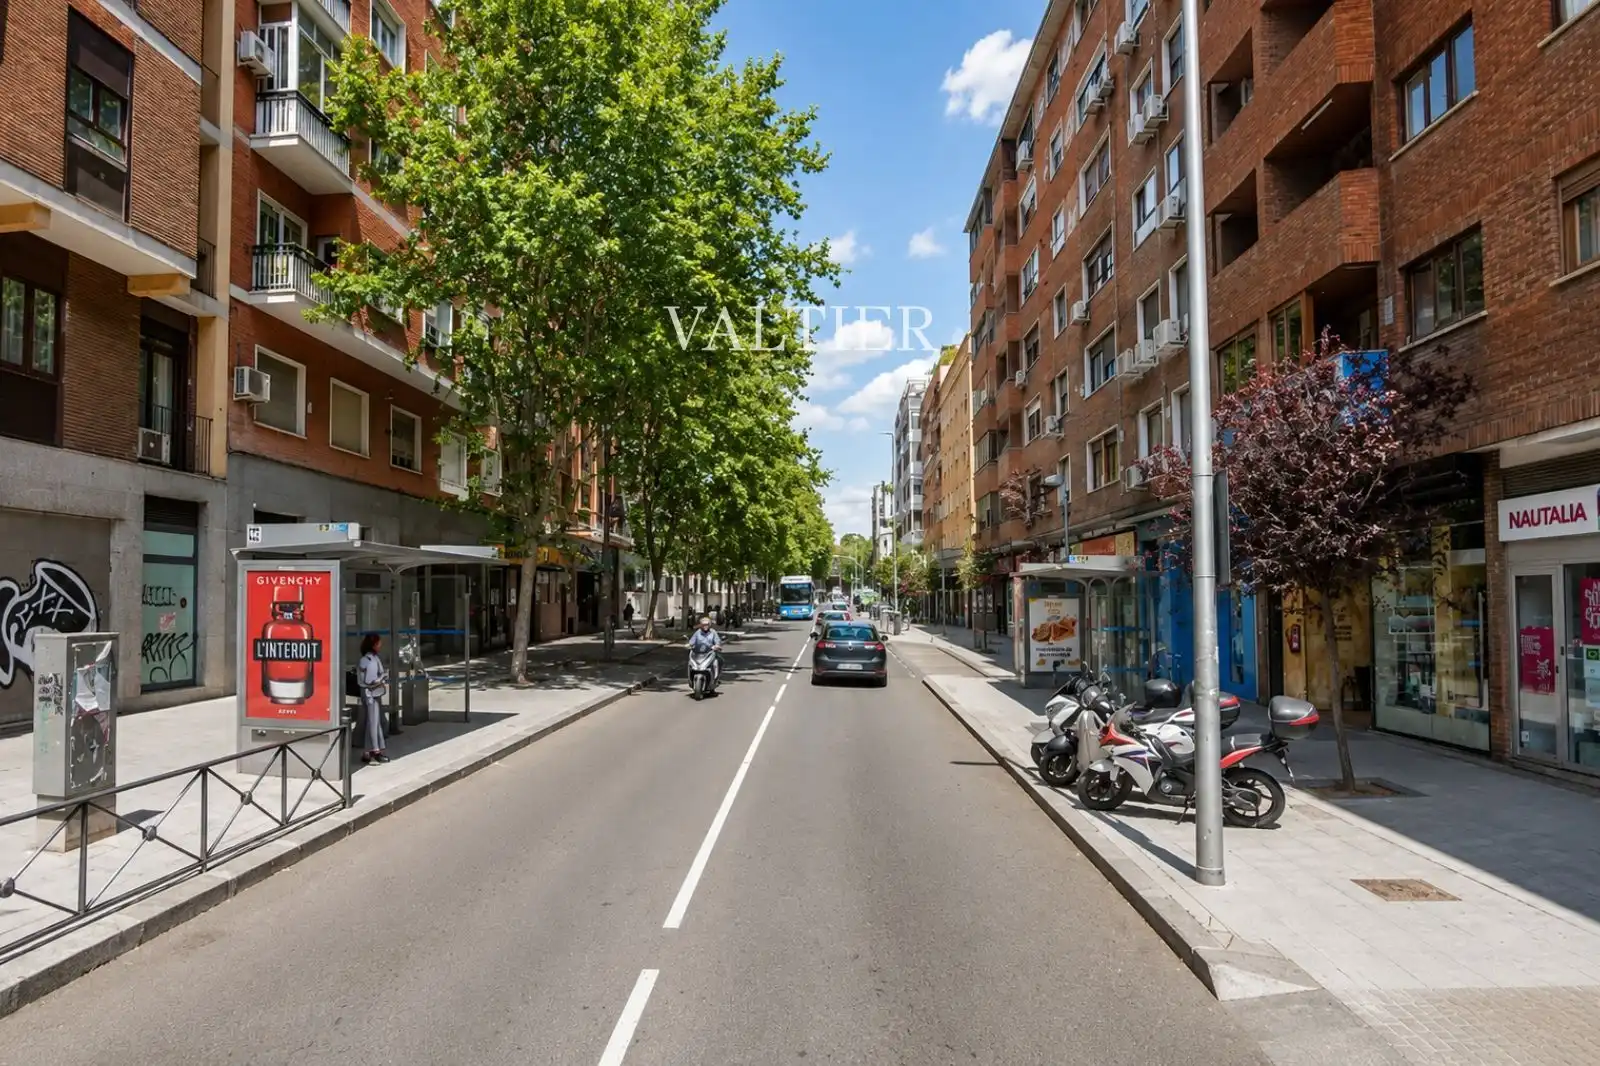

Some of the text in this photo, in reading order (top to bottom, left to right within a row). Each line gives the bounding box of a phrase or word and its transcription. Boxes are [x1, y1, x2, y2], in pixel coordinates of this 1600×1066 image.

[1509, 502, 1588, 529] NAUTALIA
[256, 576, 322, 585] GIVENCHY
[257, 641, 319, 660] L'INTERDIT
